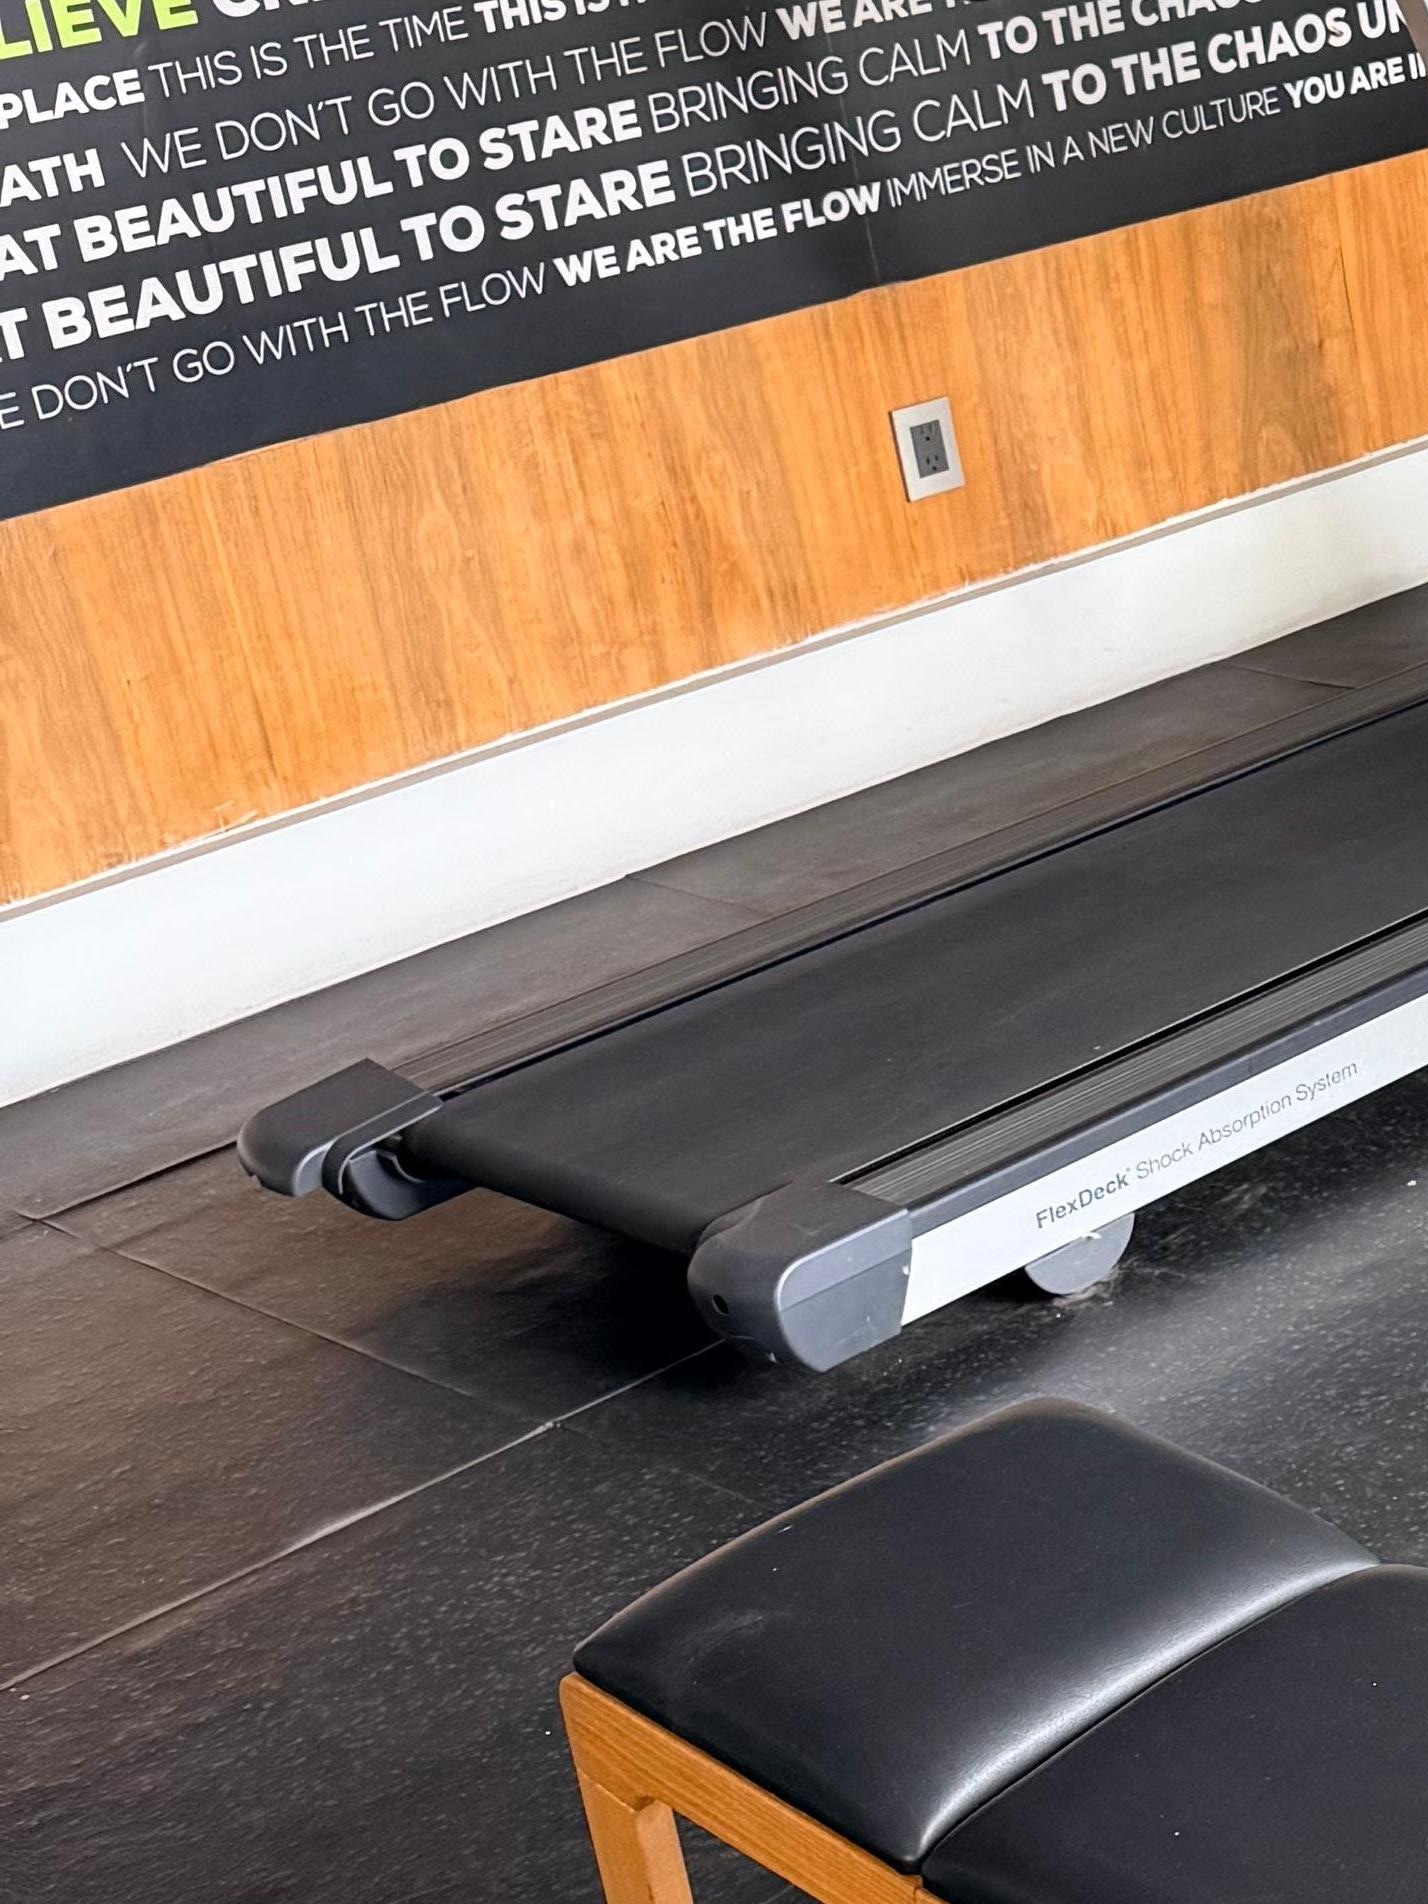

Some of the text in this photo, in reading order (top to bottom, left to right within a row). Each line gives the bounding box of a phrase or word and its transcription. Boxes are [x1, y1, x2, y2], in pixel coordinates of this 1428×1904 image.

[0, 308, 27, 362] T
[42, 227, 402, 350] BEAUTIFUL
[400, 205, 484, 260] TO
[495, 160, 675, 239] STARE
[682, 110, 902, 196] BRINGING
[913, 79, 1034, 141] CALM
[1042, 64, 1106, 111] TO
[1111, 41, 1201, 95] THE
[1208, 8, 1351, 73] CHAOS
[32, 357, 158, 419] DON'T
[173, 341, 234, 382] GO
[243, 312, 348, 364] WITH
[355, 291, 433, 335] THE
[439, 262, 544, 317] FLOW
[553, 246, 620, 286] WE
[627, 226, 702, 272] ARE
[703, 208, 777, 250] THE
[781, 182, 880, 233] FLOW
[887, 149, 1021, 207] IMMERSE
[1026, 142, 1055, 173] IN
[1064, 136, 1084, 165] A
[1088, 116, 1153, 157] NEW
[1163, 87, 1280, 138] CULTURE
[1284, 71, 1345, 108] YOU
[1350, 57, 1405, 94] ARE
[1135, 1141, 1194, 1180] Shock
[1198, 1091, 1293, 1152] Absorption
[1295, 1061, 1359, 1105] System
